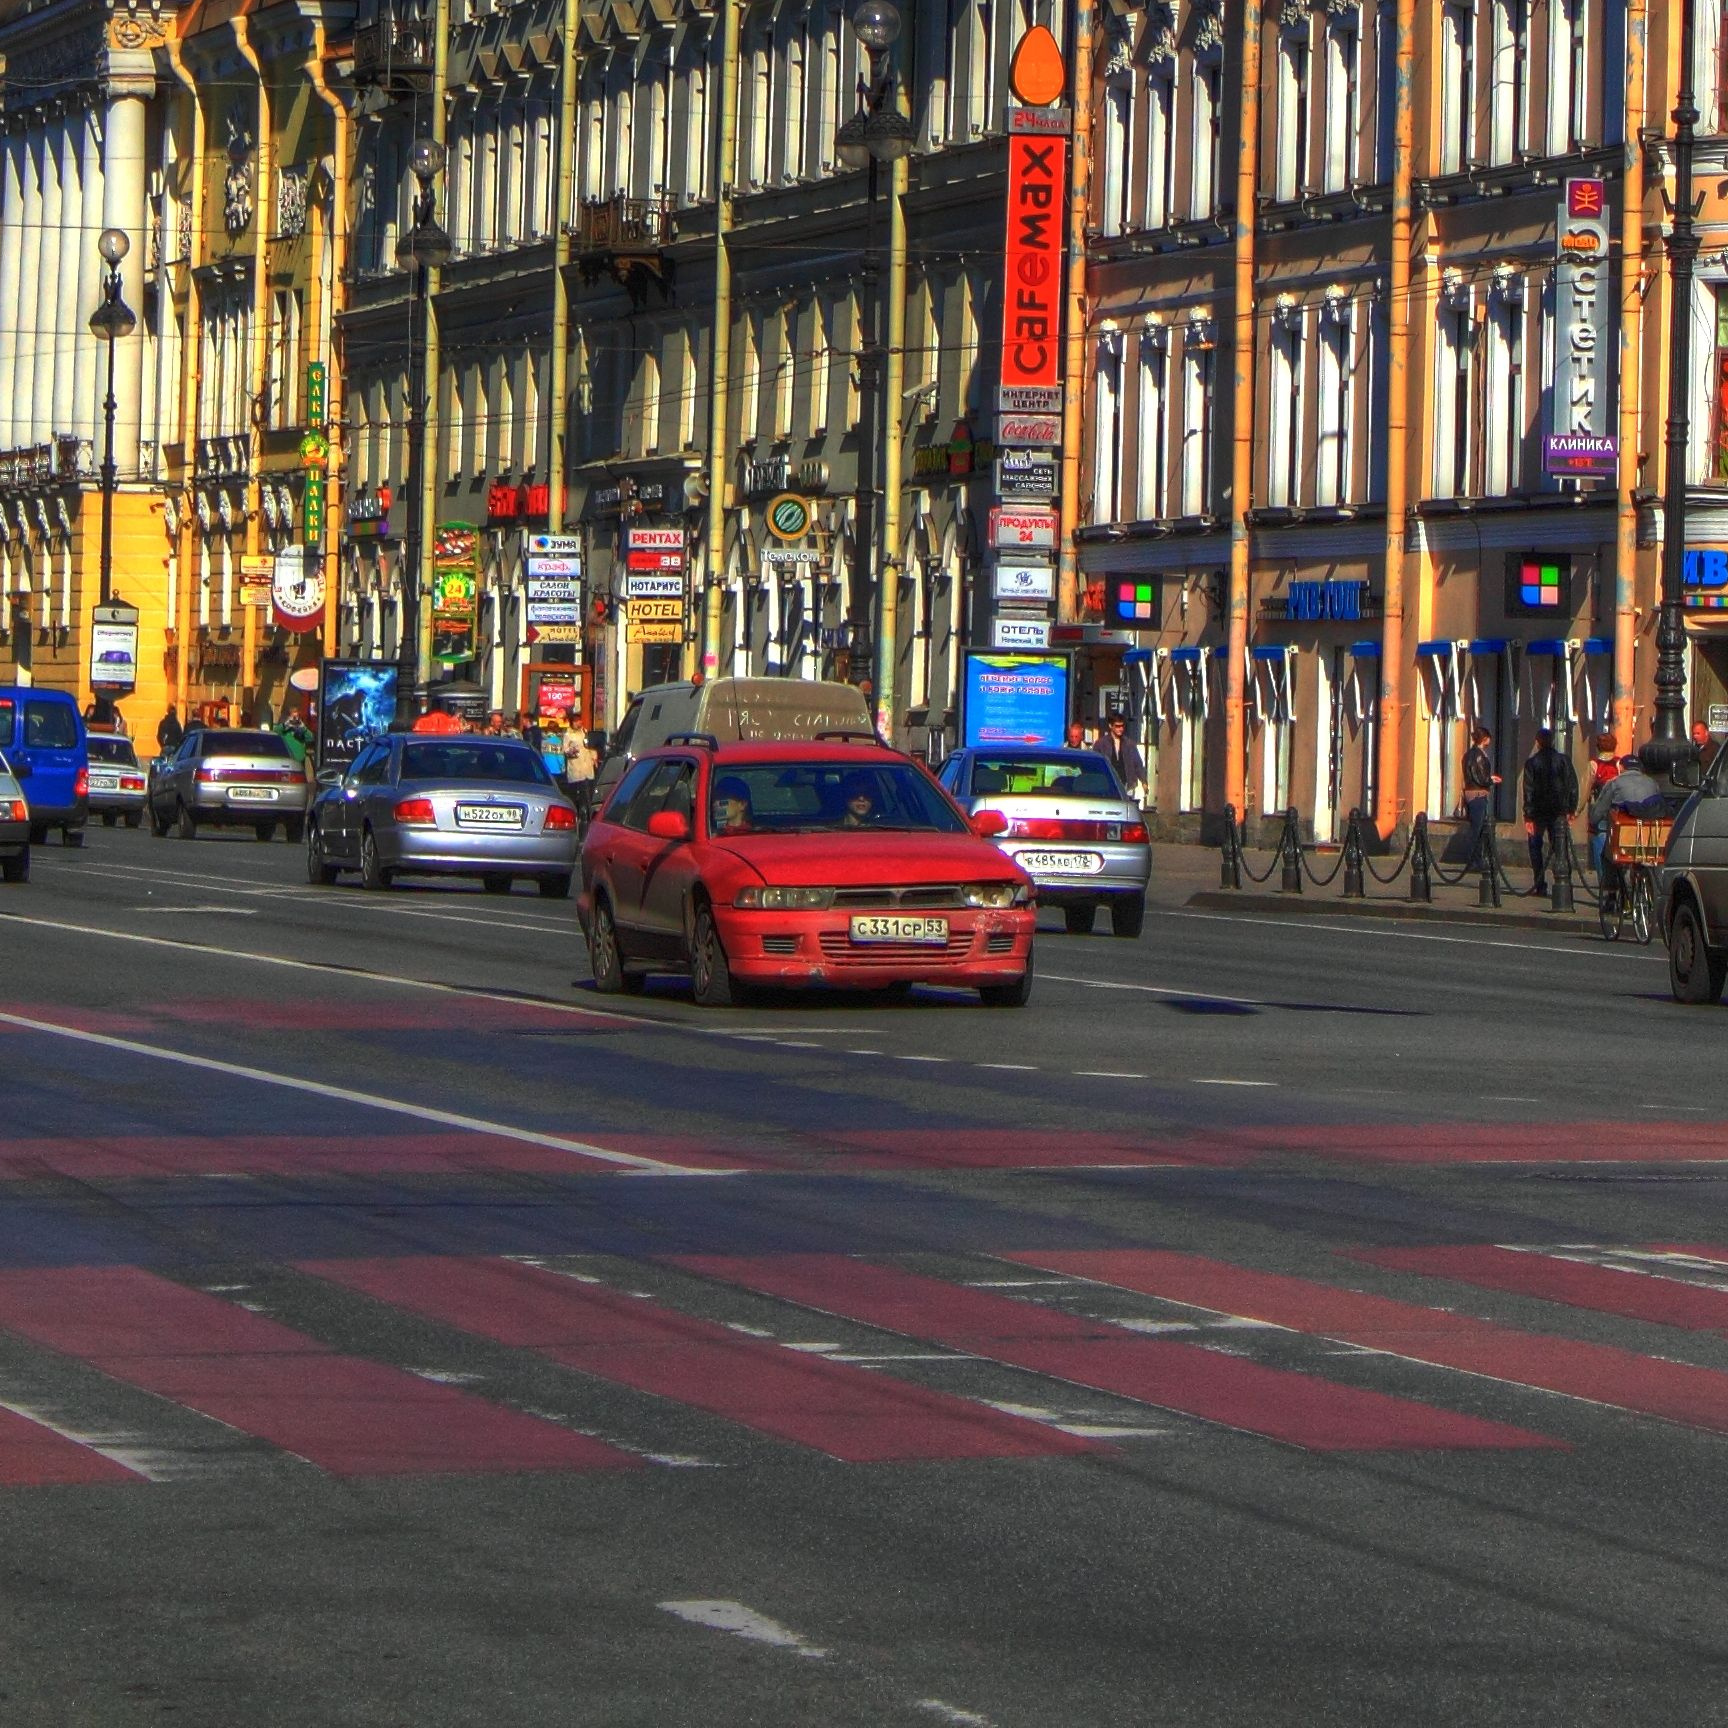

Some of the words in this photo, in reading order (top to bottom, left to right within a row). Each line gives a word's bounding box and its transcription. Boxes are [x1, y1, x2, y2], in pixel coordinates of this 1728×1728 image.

[1003, 390, 1060, 399] ИНТЕРНЕТ
[1013, 400, 1050, 409] ЦЕНТР
[1550, 438, 1613, 452] КЛИНИКА
[632, 533, 681, 544] PENTAX
[630, 581, 680, 591] НОТАРИУС
[632, 604, 680, 616] HOTEL
[1001, 626, 1044, 635] ОТЕЛЬ
